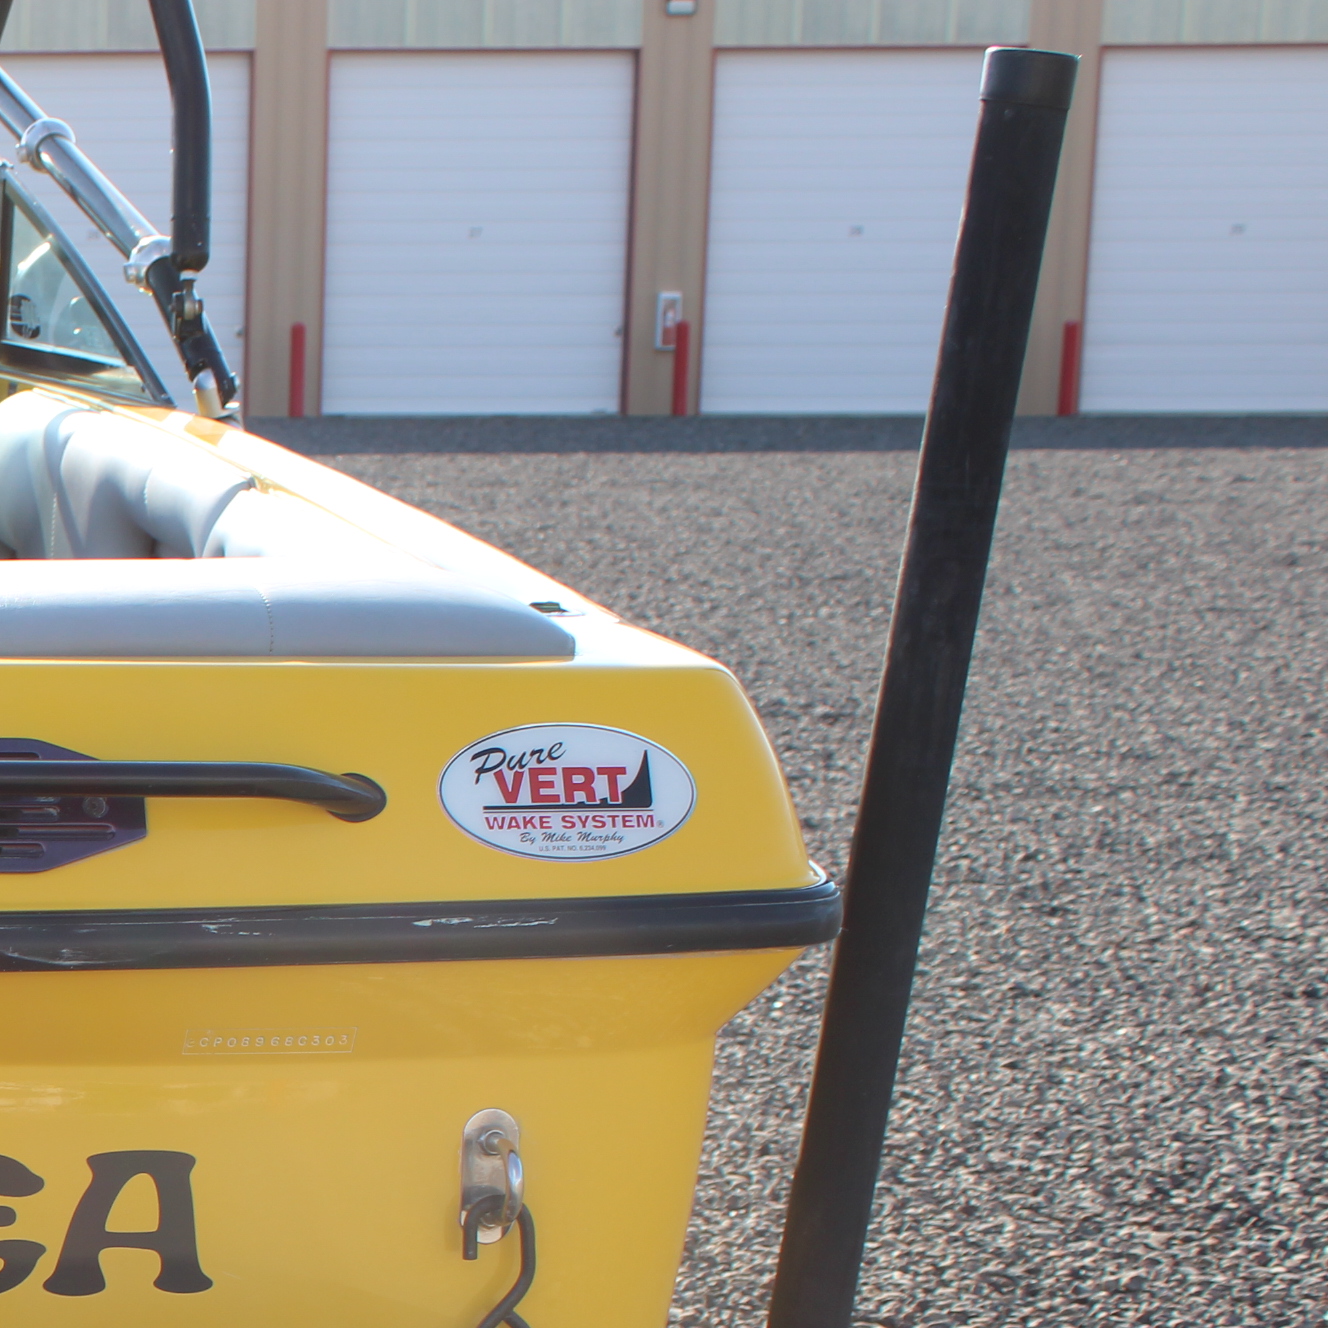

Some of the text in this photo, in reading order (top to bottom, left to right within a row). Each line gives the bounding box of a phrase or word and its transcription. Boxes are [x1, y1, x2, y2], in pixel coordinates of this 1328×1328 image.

[470, 742, 566, 785] Pure
[493, 767, 627, 804] VERT
[484, 814, 654, 830] WAKE SYSTEM
[519, 831, 624, 845] By Mike Murphy
